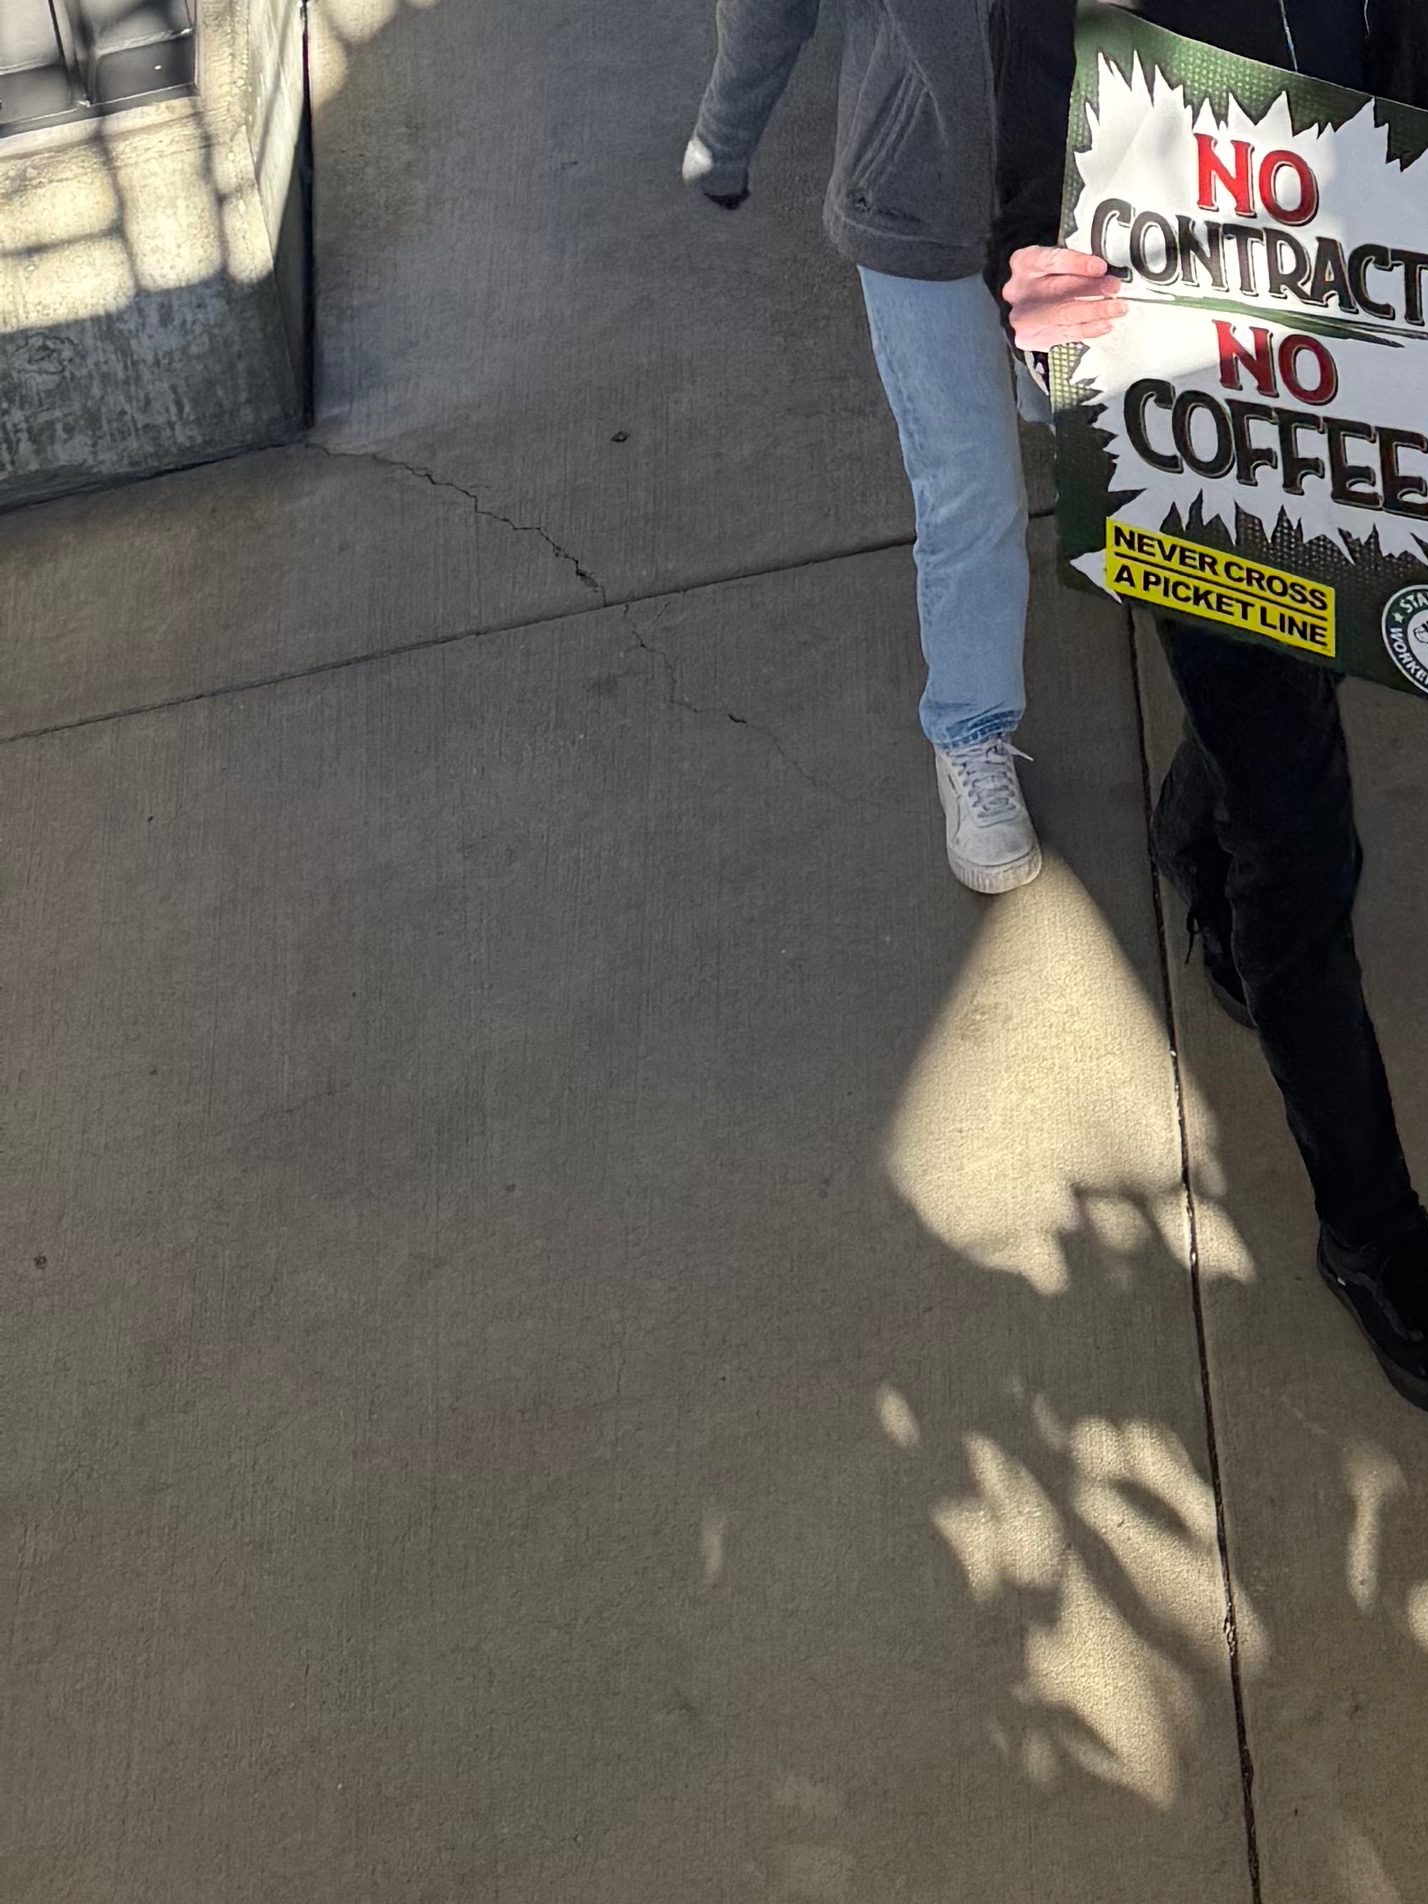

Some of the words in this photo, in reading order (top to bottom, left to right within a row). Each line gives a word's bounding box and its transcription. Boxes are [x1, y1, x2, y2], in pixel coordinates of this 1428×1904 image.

[1196, 133, 1319, 226] NO
[1216, 320, 1338, 406] NO
[1114, 526, 1220, 574] NEVER
[1223, 558, 1329, 612] CROSS
[1115, 566, 1137, 589] A
[1142, 572, 1256, 623] PICKET
[1259, 603, 1329, 648] LINE
